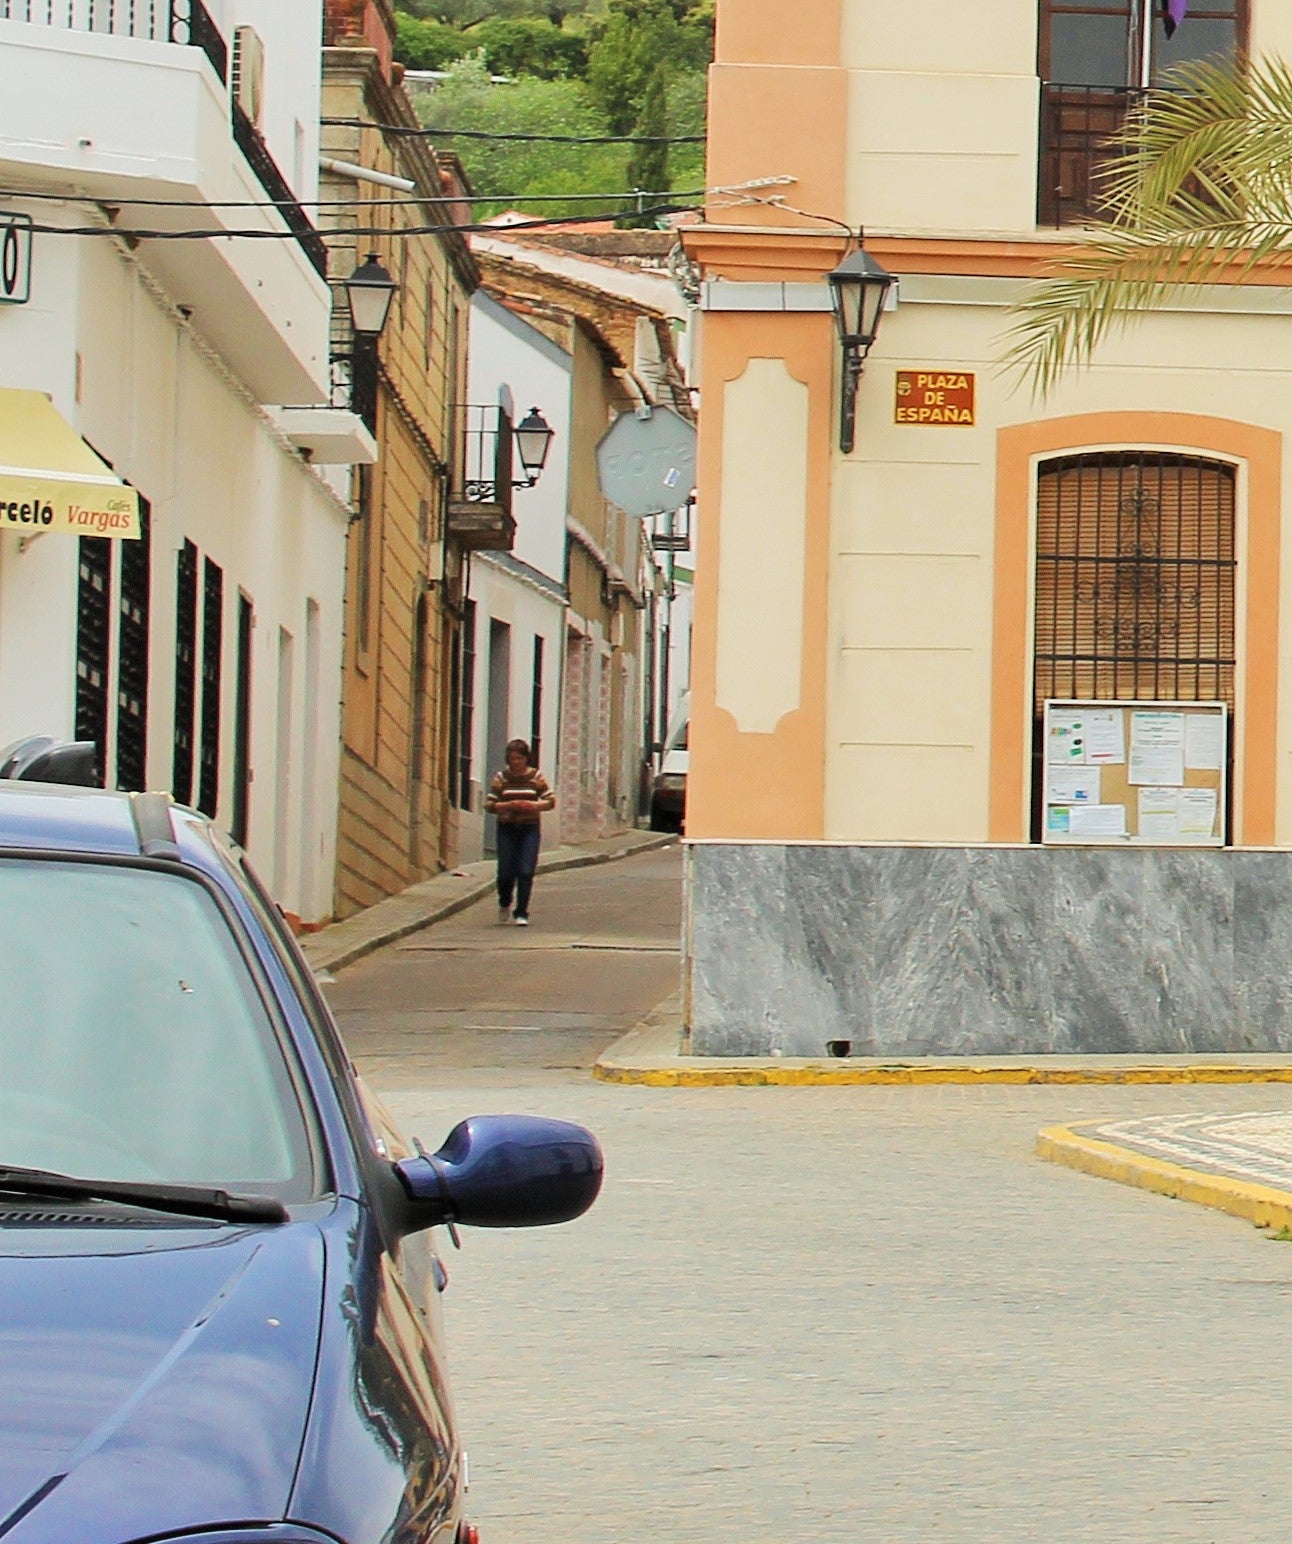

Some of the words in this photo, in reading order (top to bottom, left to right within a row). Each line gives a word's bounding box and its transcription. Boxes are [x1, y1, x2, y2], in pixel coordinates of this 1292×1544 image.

[917, 374, 969, 389] PLAZA
[924, 391, 945, 405] DE
[896, 405, 972, 423] ESPAÑA
[67, 505, 130, 532] Vargas
